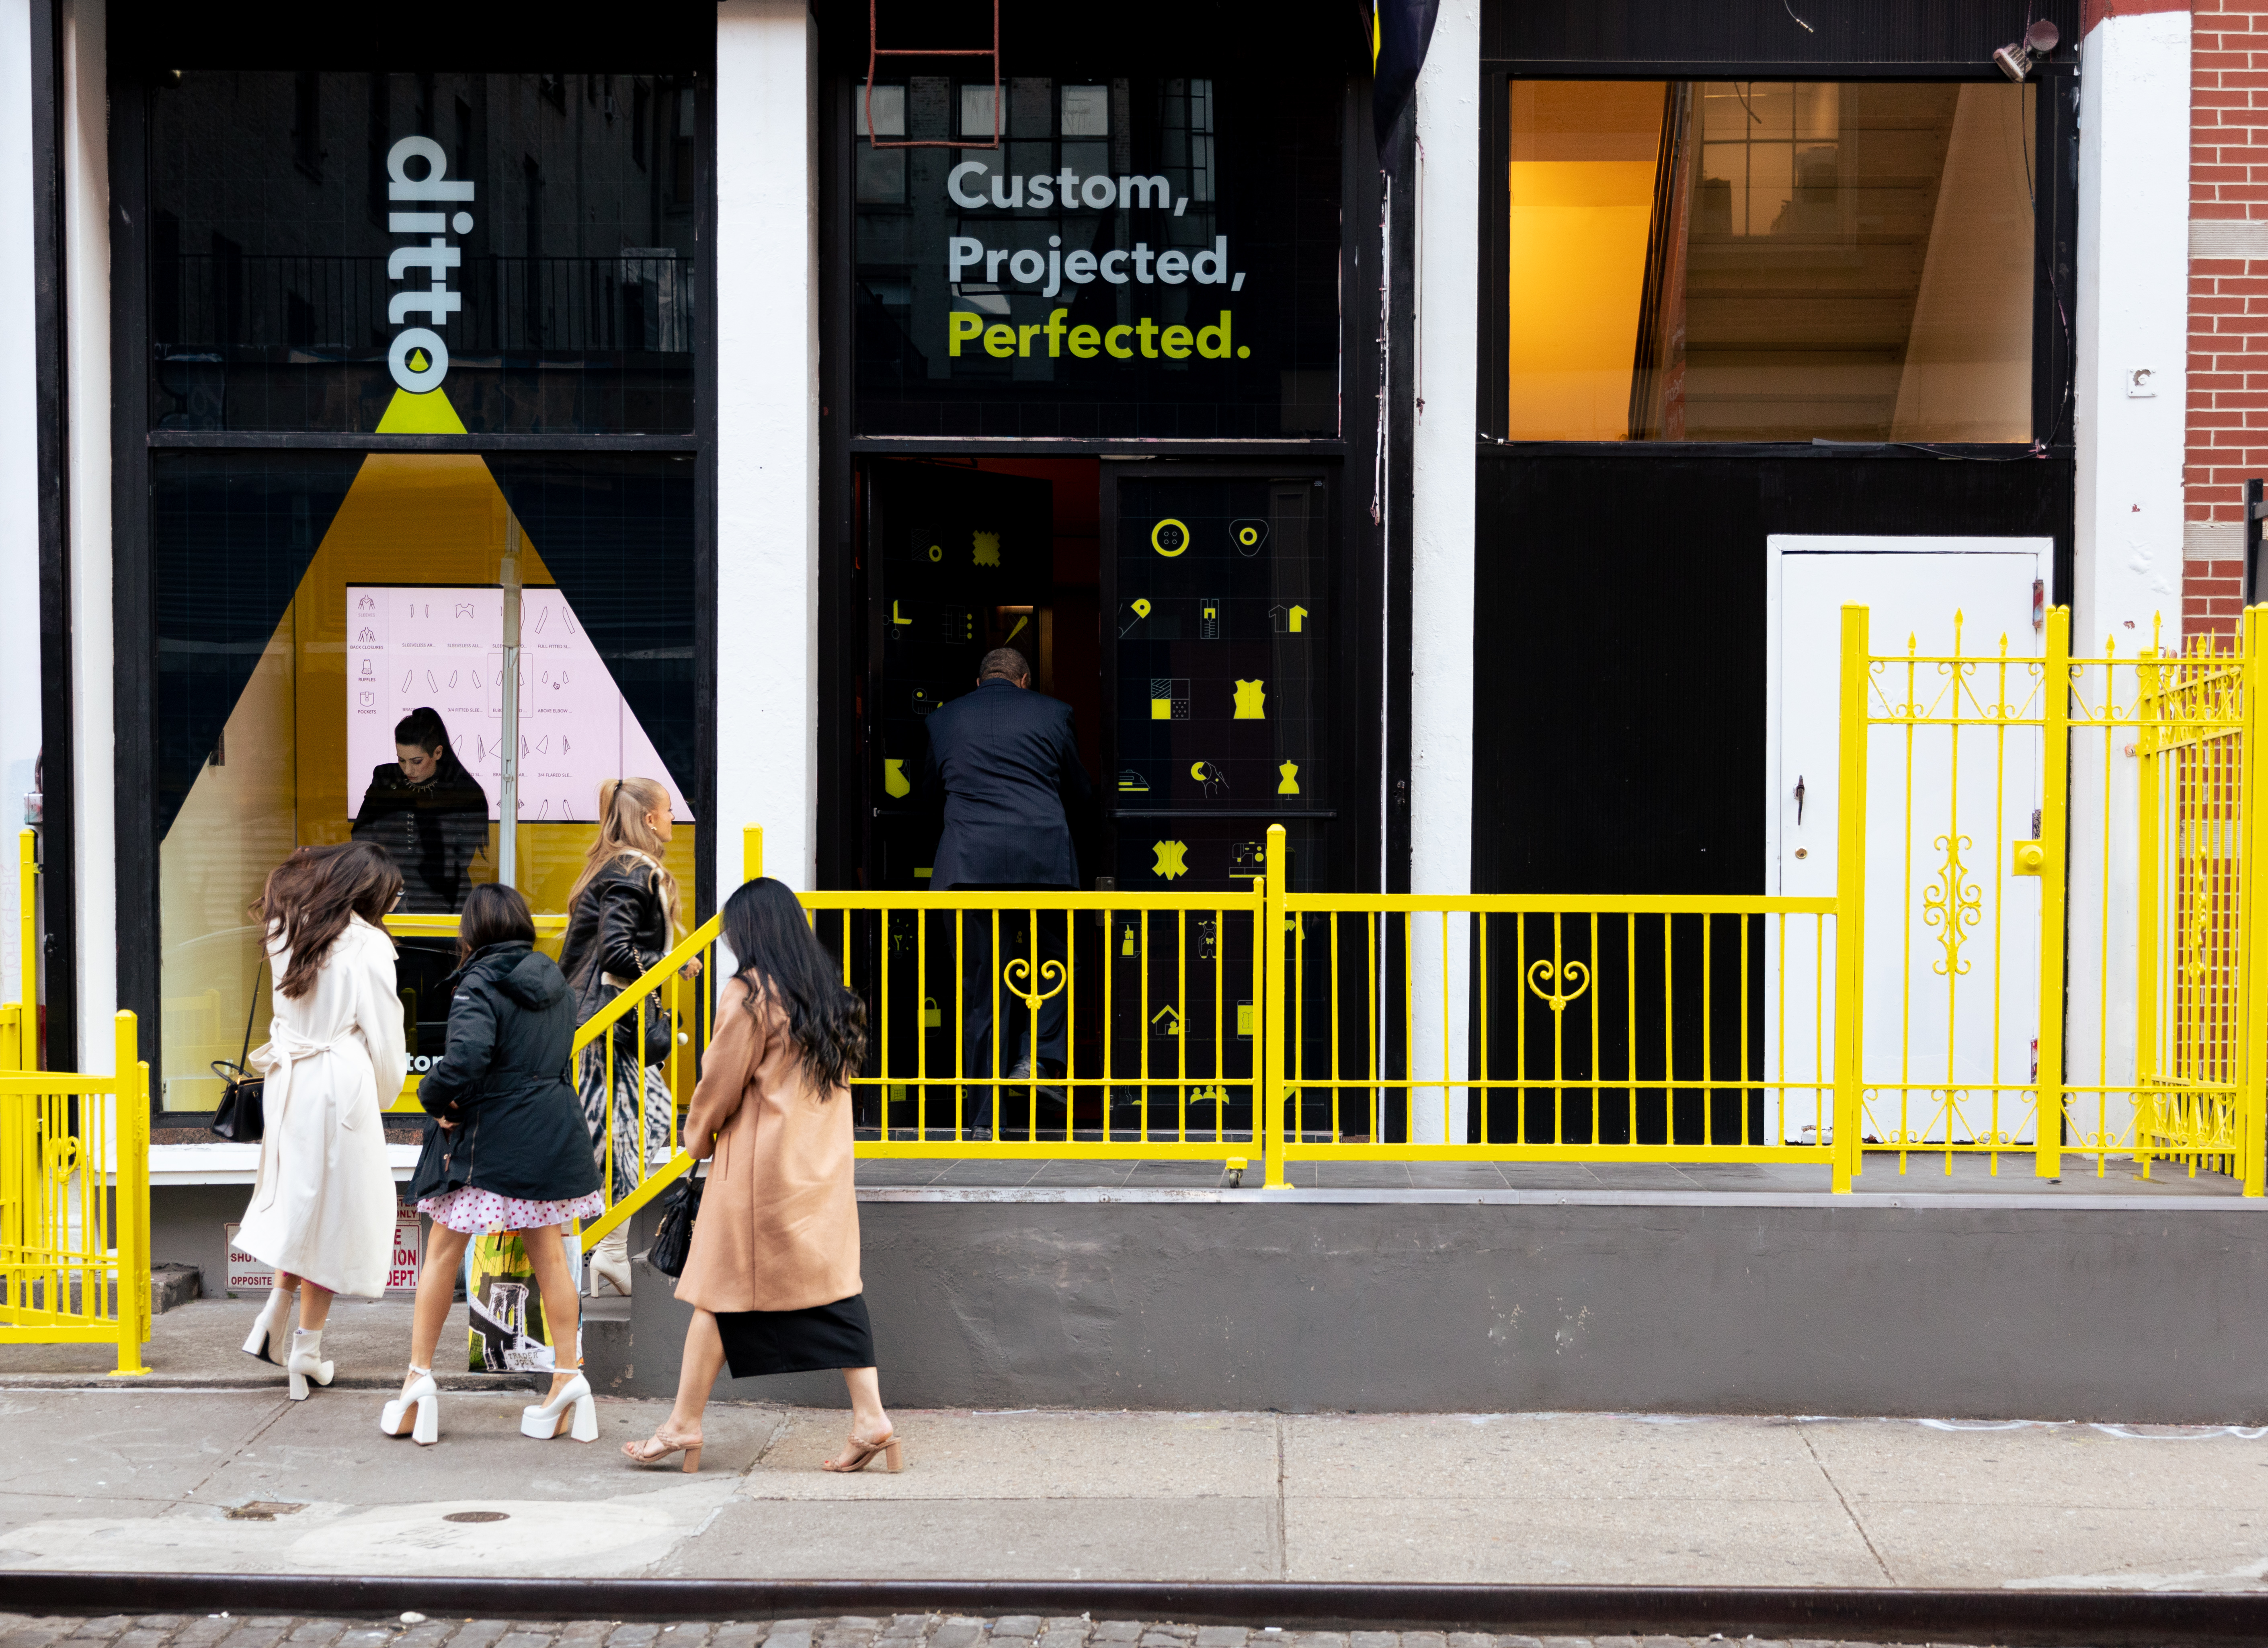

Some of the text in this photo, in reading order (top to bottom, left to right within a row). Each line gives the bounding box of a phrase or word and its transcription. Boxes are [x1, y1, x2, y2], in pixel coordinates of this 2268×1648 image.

[948, 161, 1188, 216] Custom,
[387, 136, 474, 392] ditto
[949, 236, 1245, 297] Projected,
[949, 308, 1250, 358] Perfected.
[231, 1277, 272, 1285] OPPOSITE
[508, 1351, 538, 1359] TRADER
